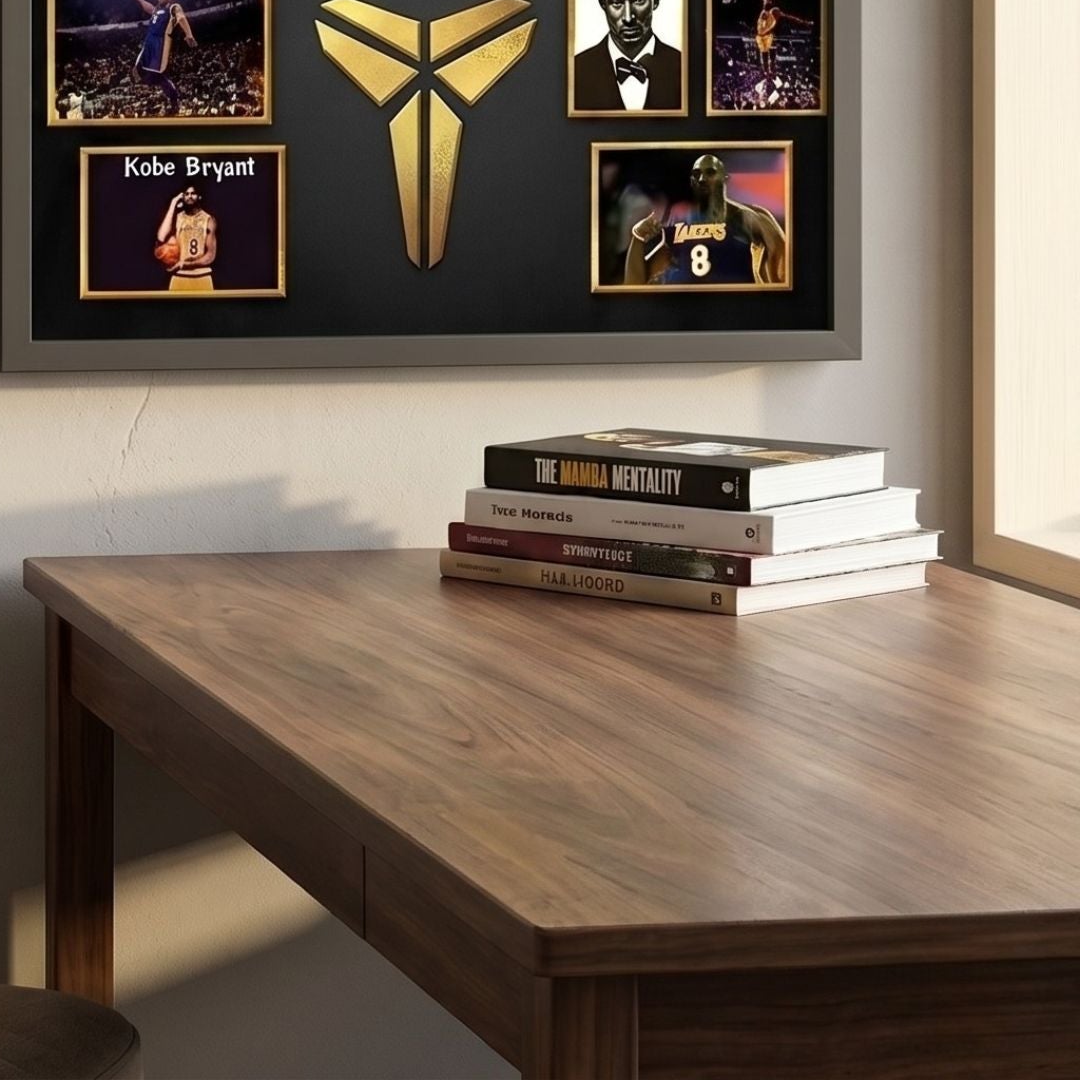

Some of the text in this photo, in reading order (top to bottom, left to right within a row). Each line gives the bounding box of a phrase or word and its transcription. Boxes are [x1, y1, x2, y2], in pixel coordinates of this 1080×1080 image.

[124, 155, 255, 182] Kobe Bryant
[190, 238, 198, 256] 8
[690, 244, 712, 277] 8
[534, 457, 682, 496] THE MAMBA MENTALITY
